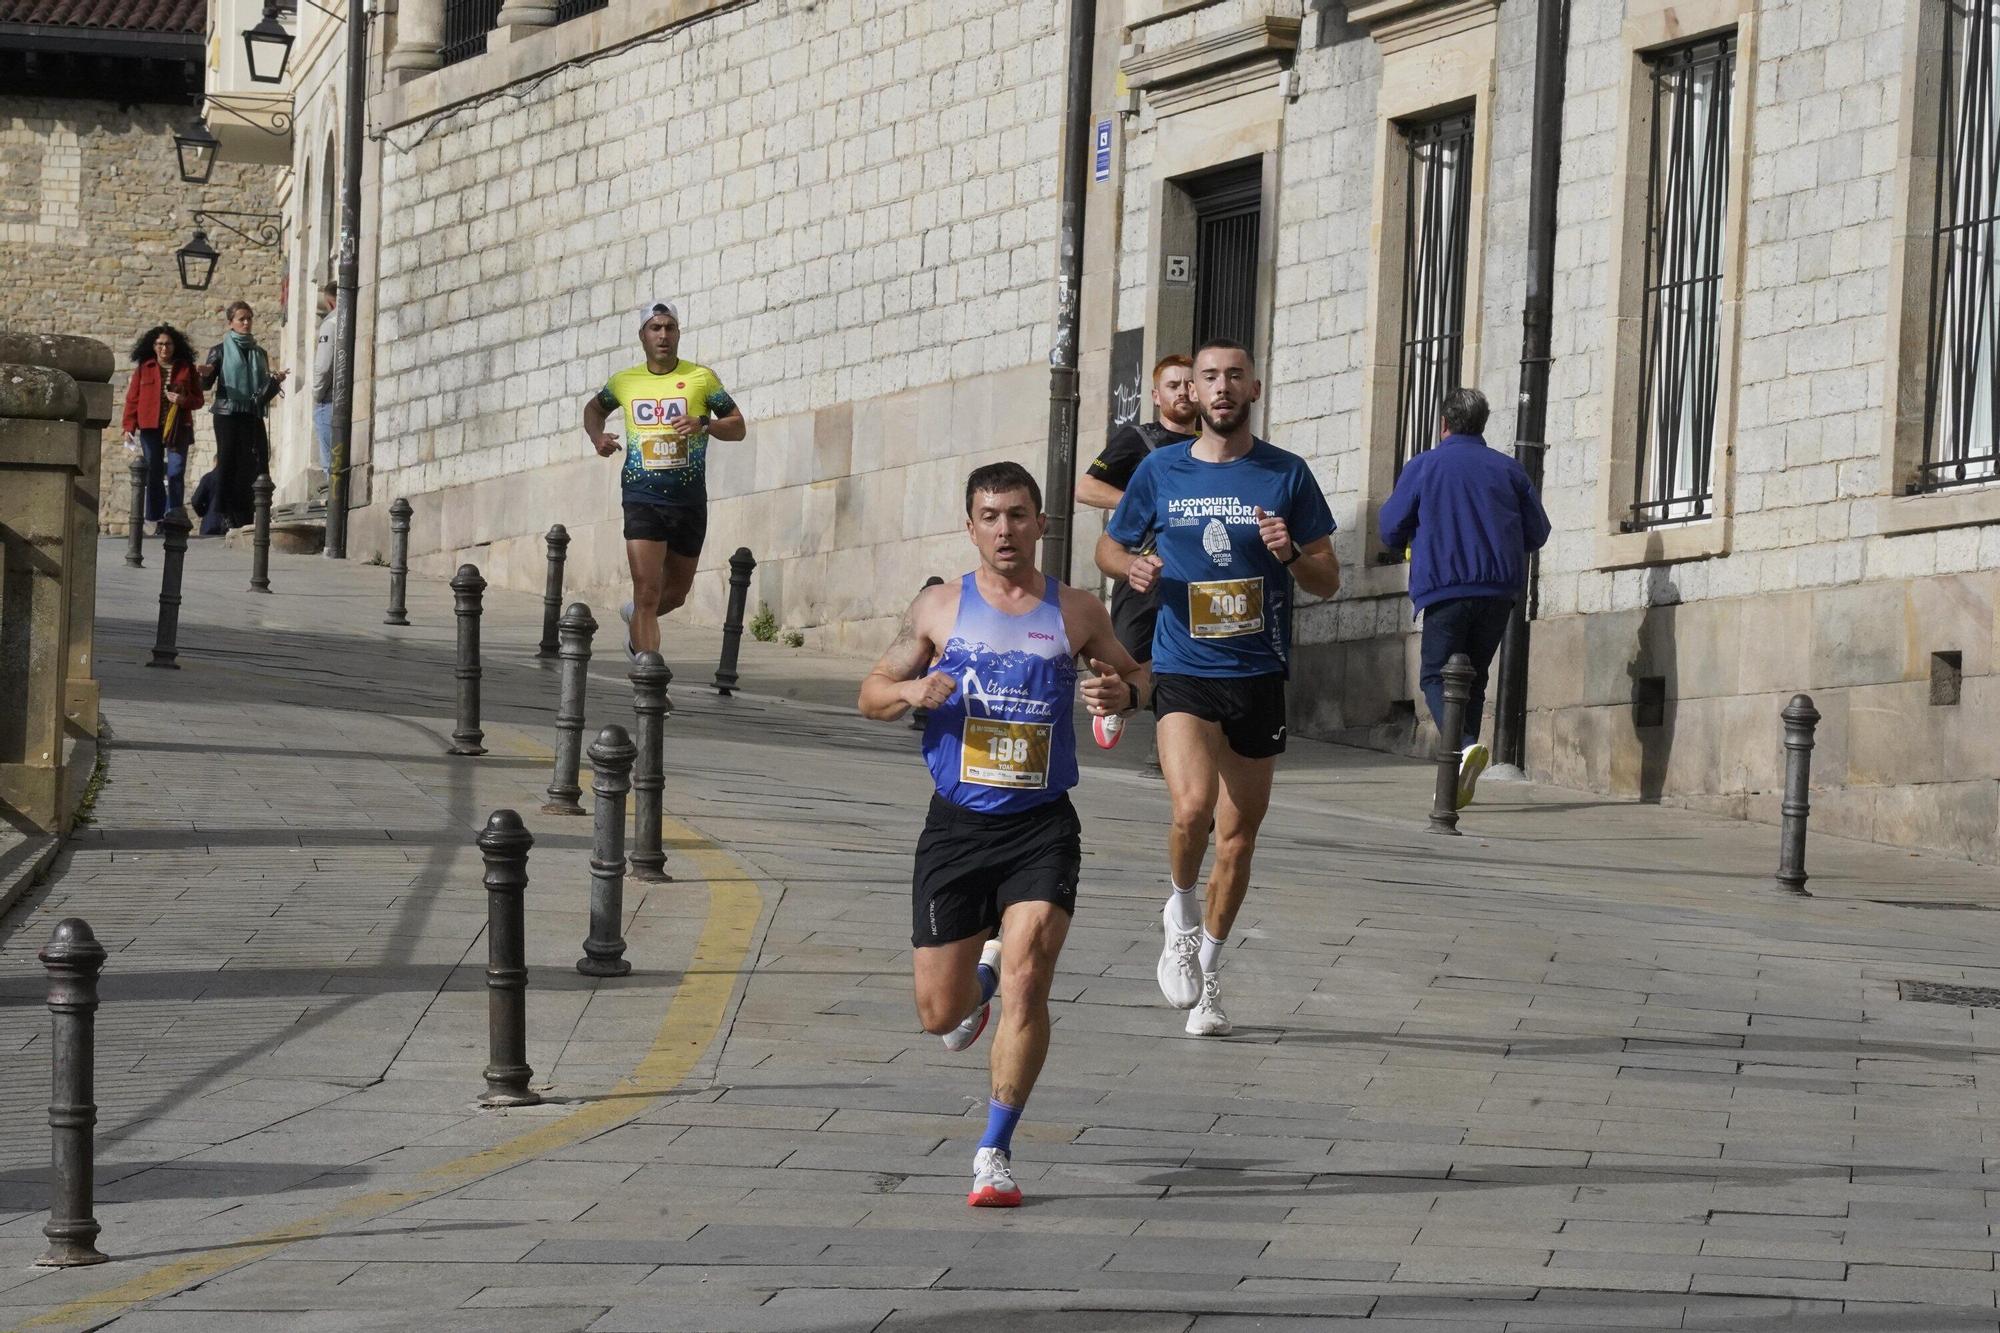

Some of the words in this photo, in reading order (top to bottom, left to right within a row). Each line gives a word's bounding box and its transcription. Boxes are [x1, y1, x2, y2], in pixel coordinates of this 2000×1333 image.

[1181, 497, 1240, 506] CONQUISTA
[1210, 593, 1248, 616] 406
[987, 737, 1028, 763] 198
